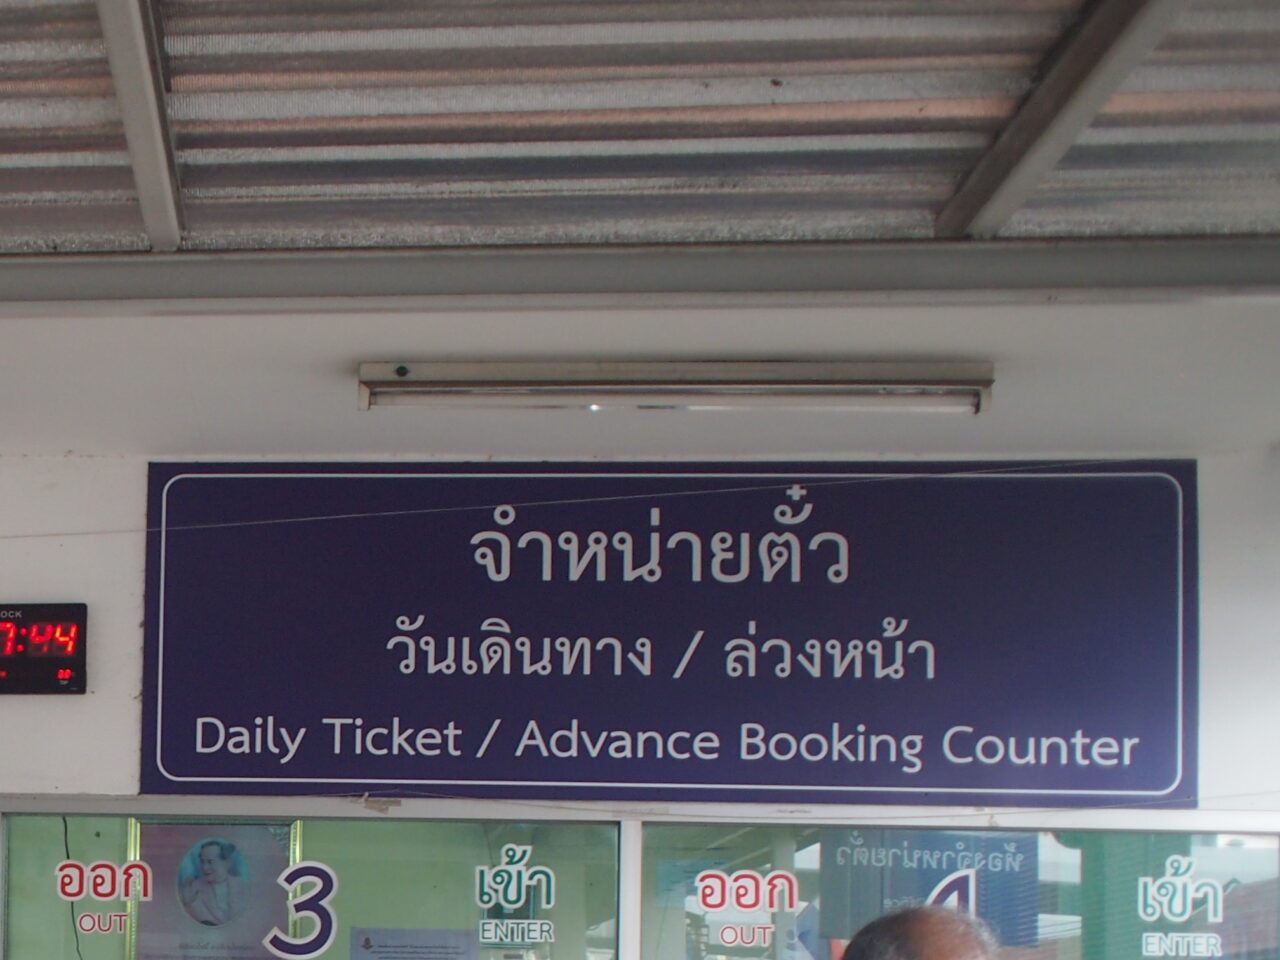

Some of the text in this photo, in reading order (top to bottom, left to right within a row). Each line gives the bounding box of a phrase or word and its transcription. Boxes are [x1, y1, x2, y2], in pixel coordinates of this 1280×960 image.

[470, 484, 849, 585] จำหน่ายตั๋ว
[386, 614, 936, 681] วันเดินทาง / ล่วงหน้า
[195, 715, 1141, 775] Daily Ticket / Advance Booking Counter
[57, 862, 152, 899] ออก
[478, 846, 553, 906] เข้า
[699, 873, 796, 910] ออก
[1142, 858, 1220, 922] เข้า
[78, 913, 128, 933] OUT
[267, 864, 336, 957] 3
[481, 921, 553, 940] ENTER
[720, 926, 773, 946] OUT
[1144, 935, 1221, 954] ENTER
